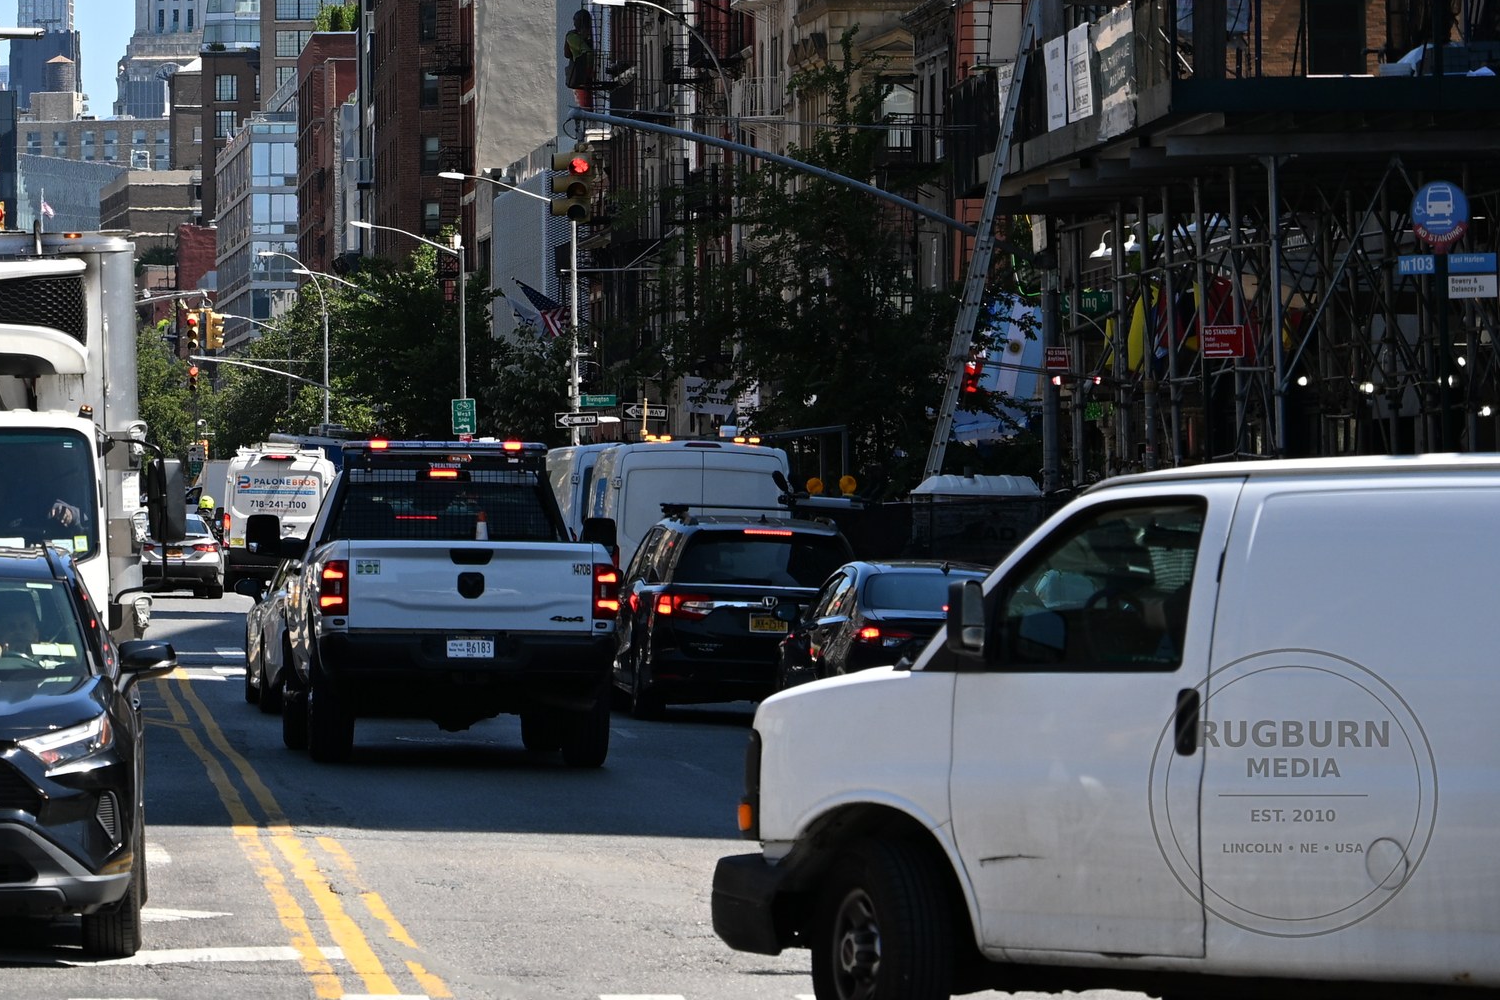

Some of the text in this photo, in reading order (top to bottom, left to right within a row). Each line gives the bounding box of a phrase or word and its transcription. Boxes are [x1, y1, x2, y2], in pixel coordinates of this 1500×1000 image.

[1417, 225, 1463, 242] NO STANDING
[1400, 256, 1434, 272] M103
[1450, 256, 1463, 264] East
[1451, 278, 1473, 286] Bowery
[1451, 285, 1477, 294] Delancey
[1102, 293, 1109, 303] St
[1213, 328, 1237, 336] STANDING
[586, 395, 610, 404] Rivington
[250, 500, 307, 509] 718-241-1100
[357, 564, 379, 574] DOT
